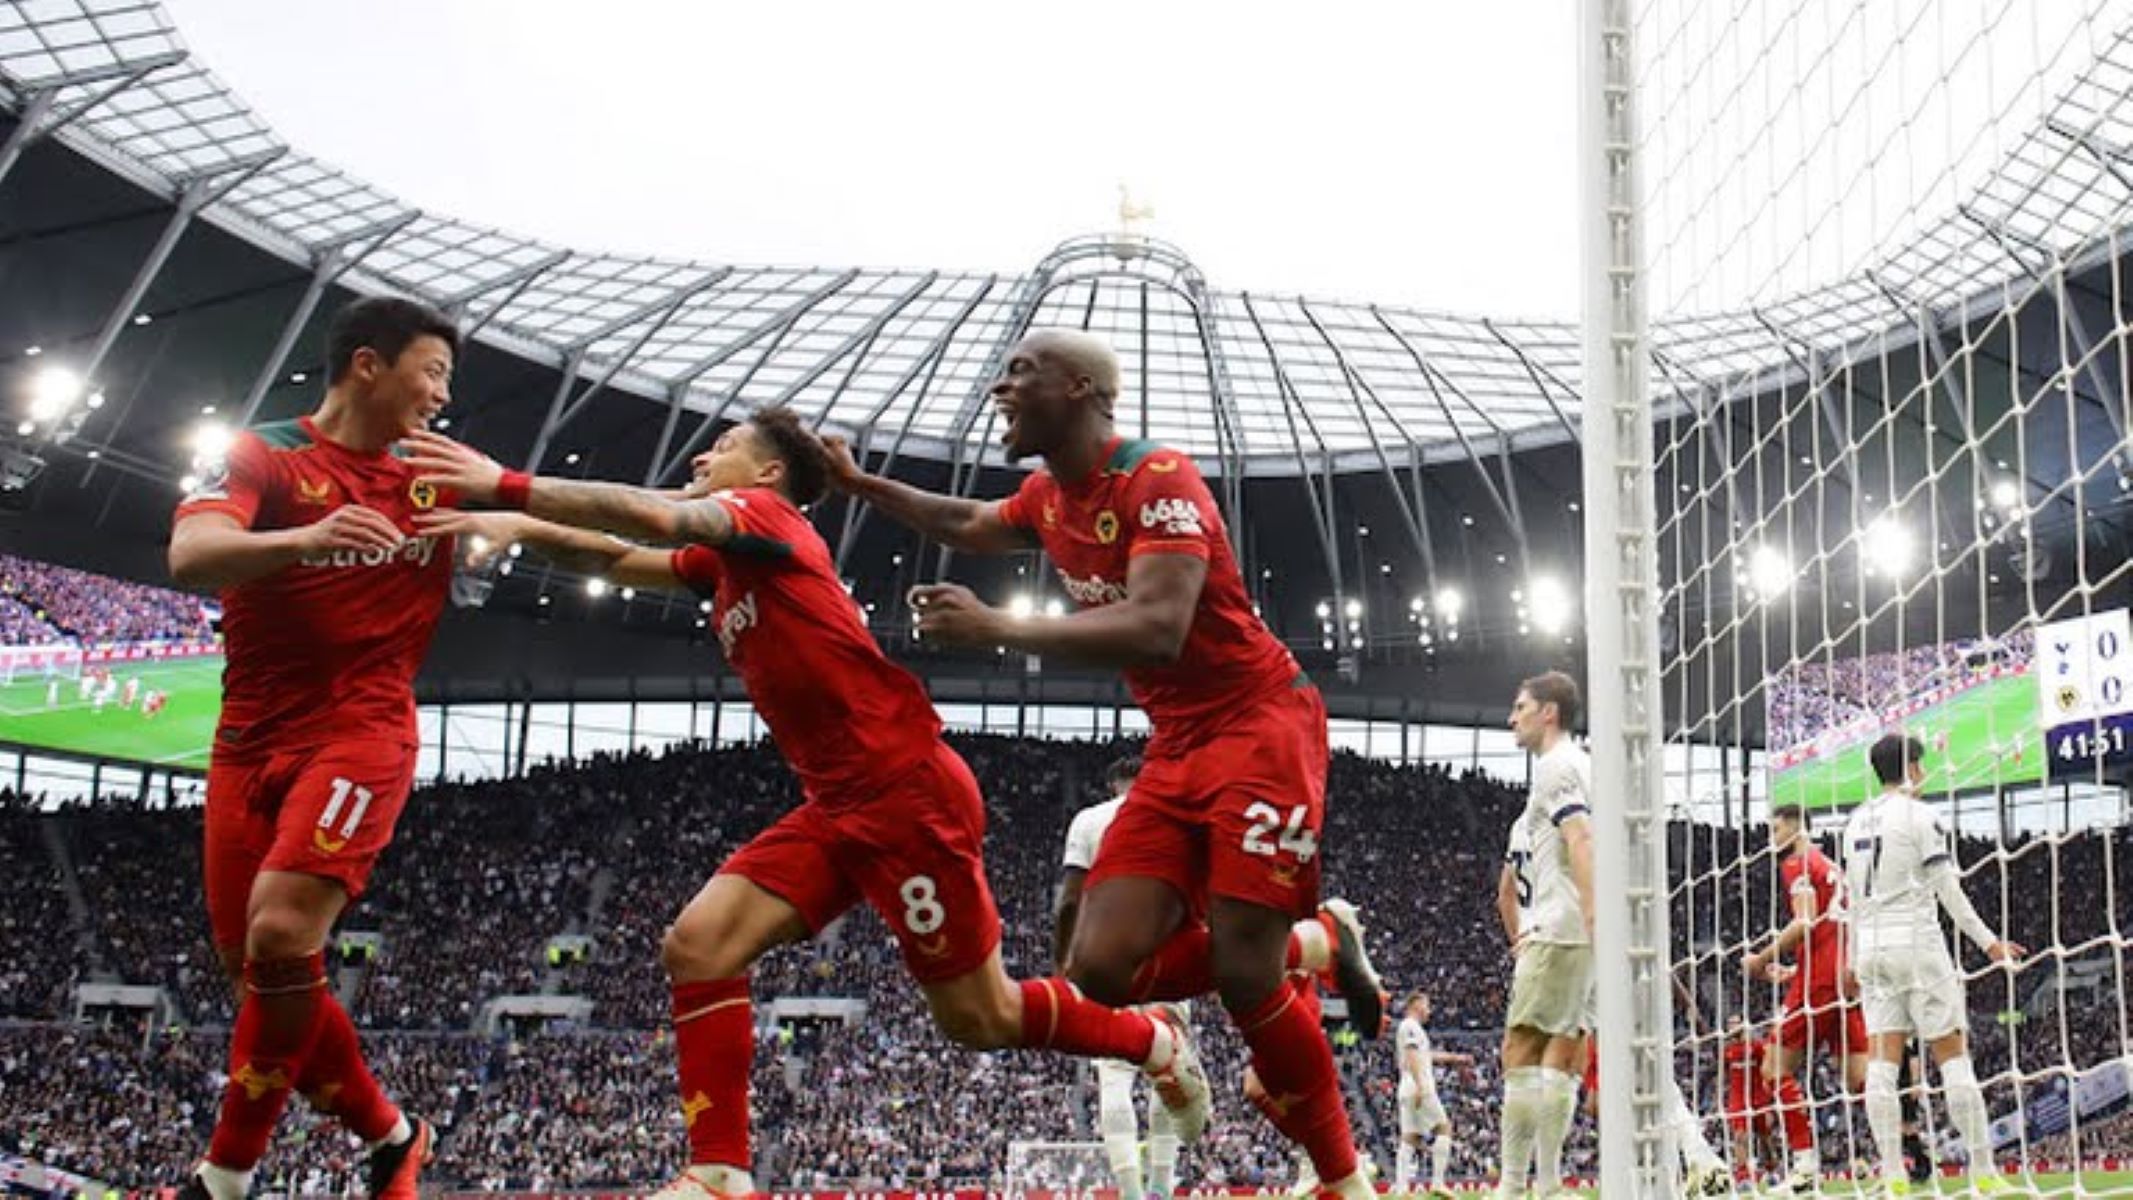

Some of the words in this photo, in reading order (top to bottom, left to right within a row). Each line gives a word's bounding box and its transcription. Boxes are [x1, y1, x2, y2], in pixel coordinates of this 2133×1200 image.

[1140, 498, 1200, 528] 6686
[2098, 630, 2117, 660] 0
[2102, 676, 2122, 705] 0
[317, 776, 373, 840] 11
[1242, 800, 1318, 864] 24
[900, 874, 945, 935] 8
